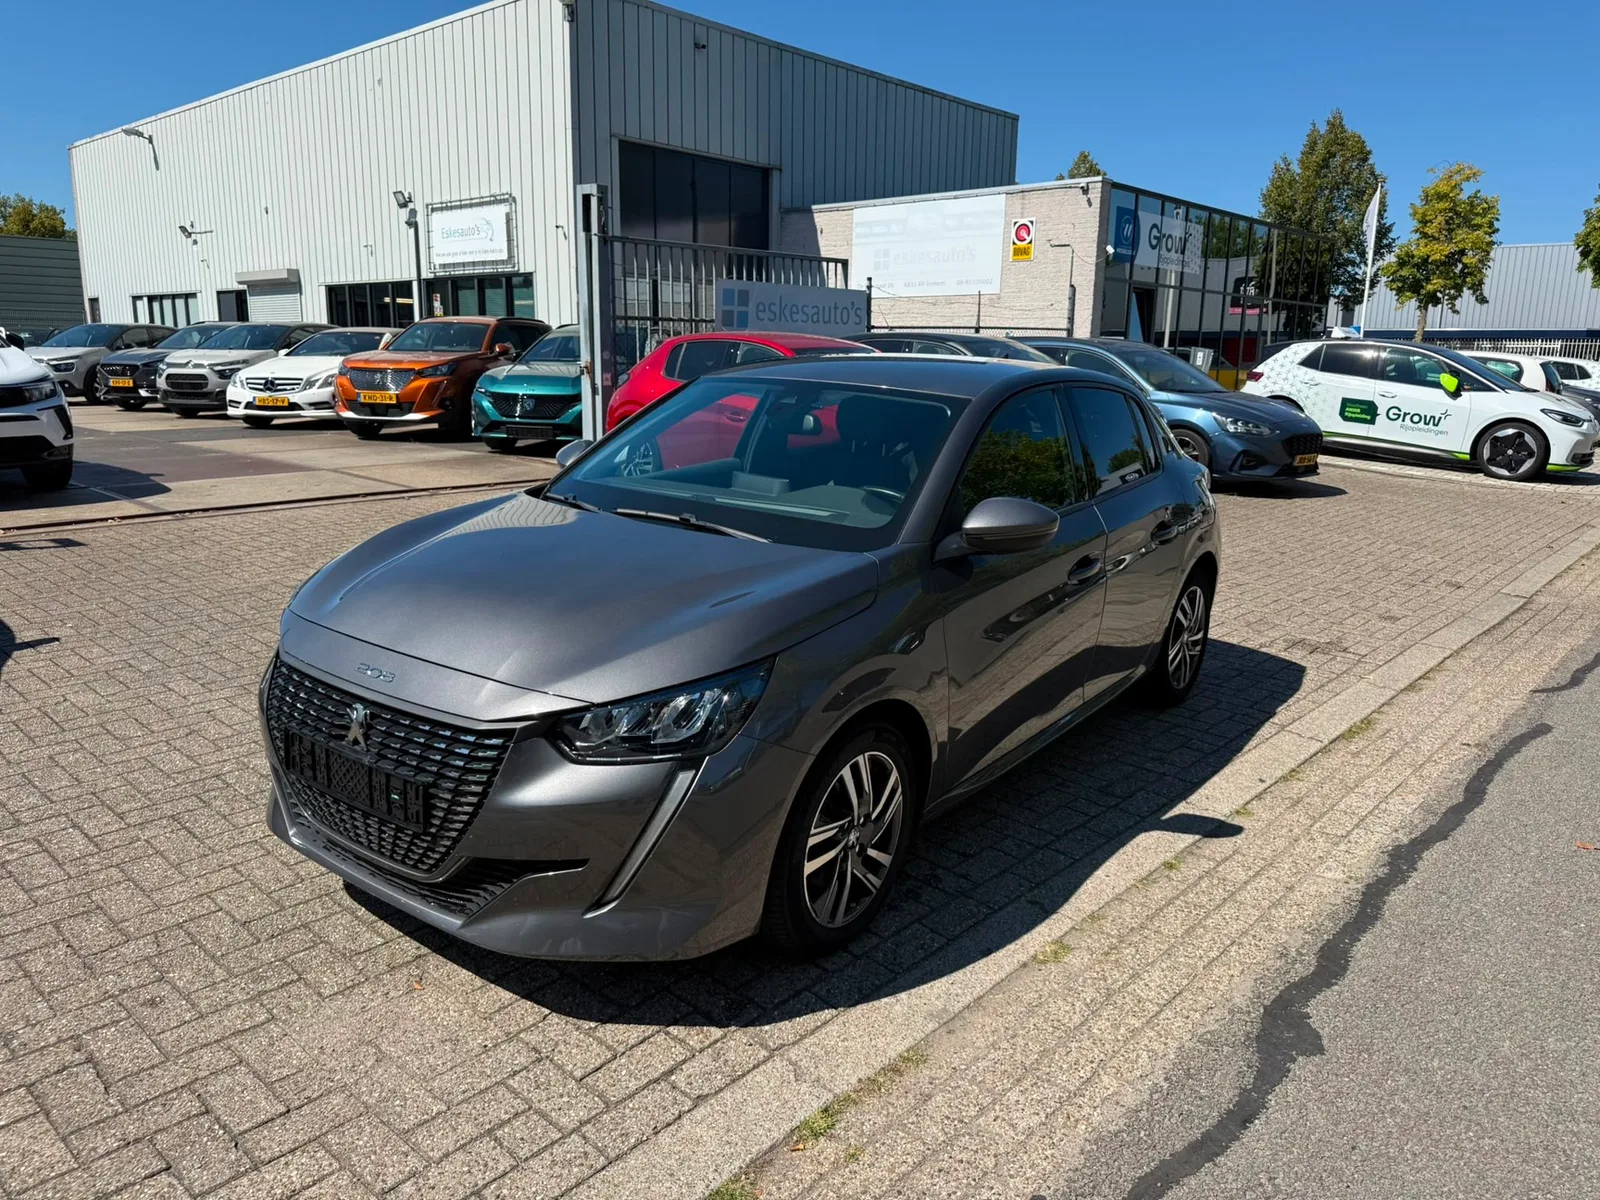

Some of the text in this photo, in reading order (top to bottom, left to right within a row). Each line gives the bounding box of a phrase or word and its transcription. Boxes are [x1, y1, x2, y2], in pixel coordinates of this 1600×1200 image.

[441, 225, 481, 239] Eskesauto's
[1013, 246, 1031, 257] BOVAG
[755, 294, 863, 326] eskesauto's
[1386, 406, 1442, 427] Grow
[1400, 423, 1449, 436] Rijopleidingen
[355, 662, 396, 683] 208
